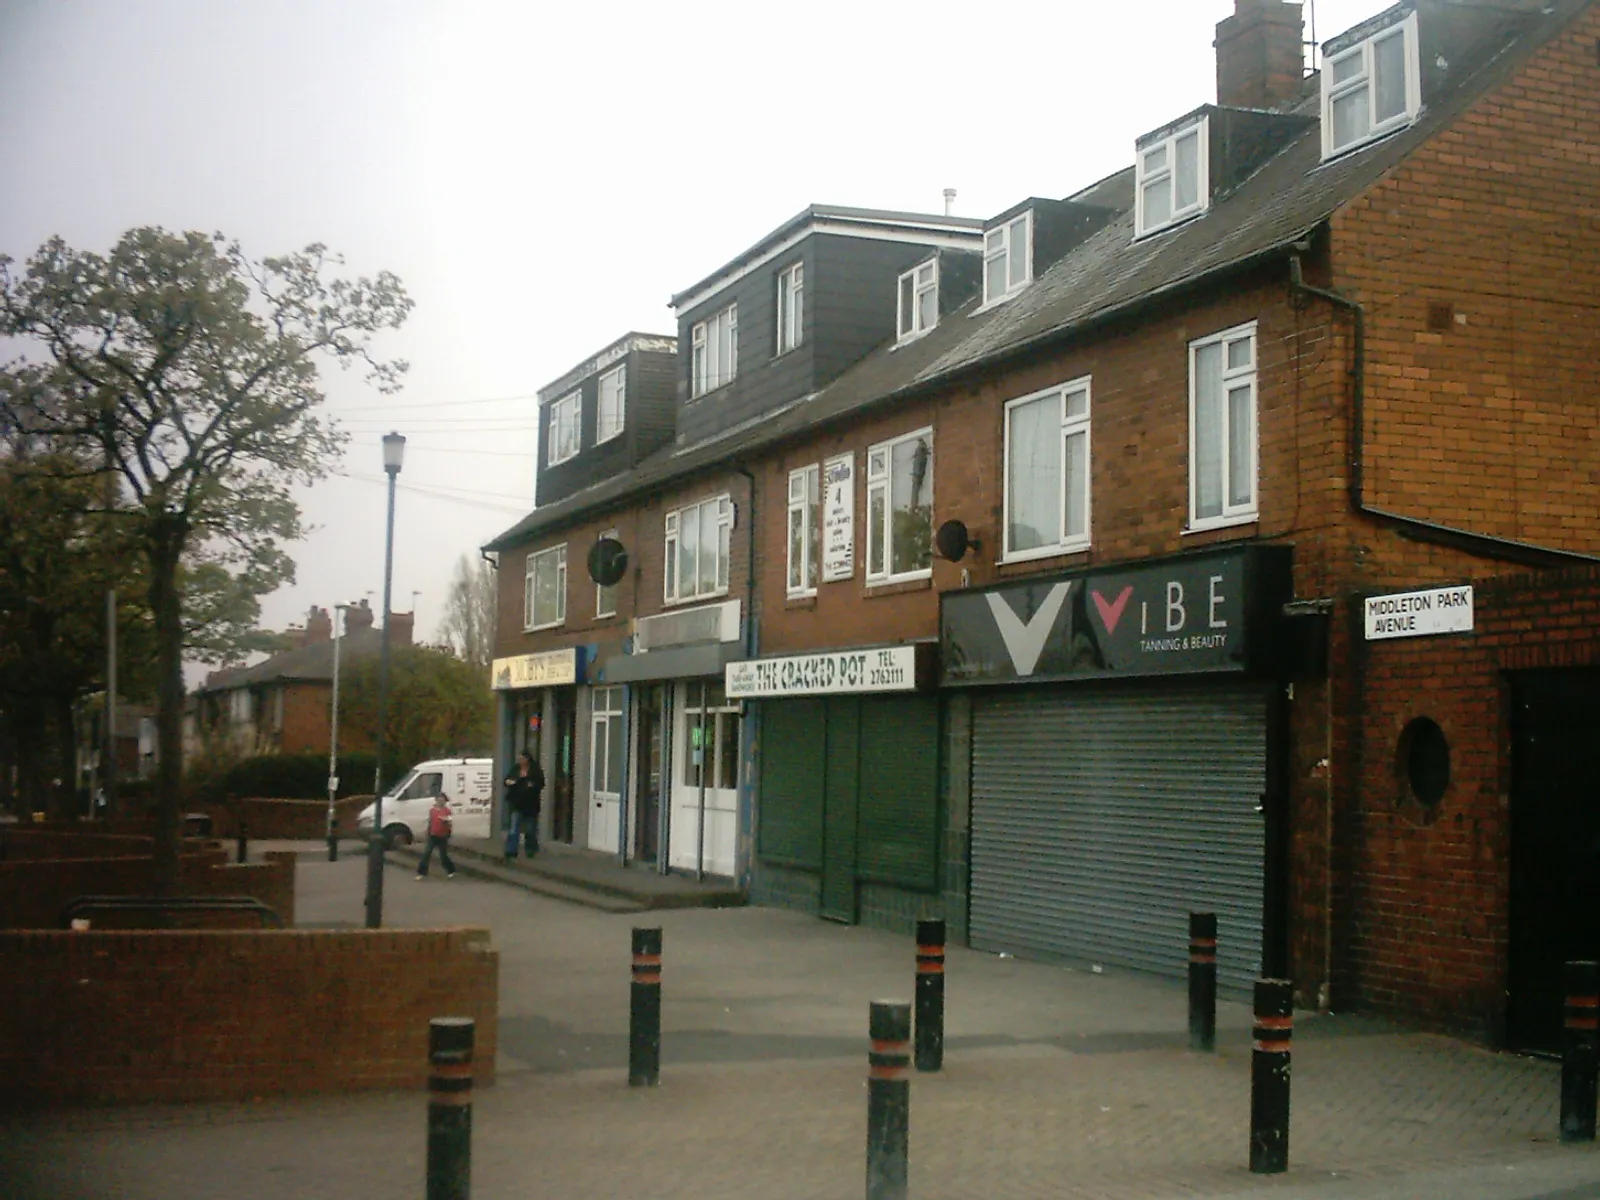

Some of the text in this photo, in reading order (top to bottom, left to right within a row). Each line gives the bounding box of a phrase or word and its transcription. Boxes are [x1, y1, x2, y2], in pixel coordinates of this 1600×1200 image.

[1368, 591, 1469, 616] MIDDLETON PARK
[1375, 615, 1416, 632] AVENUE
[1140, 634, 1228, 652] TANNING & BEAUTY
[756, 655, 866, 690] THE CRACKED POT
[870, 667, 904, 685] 2762111
